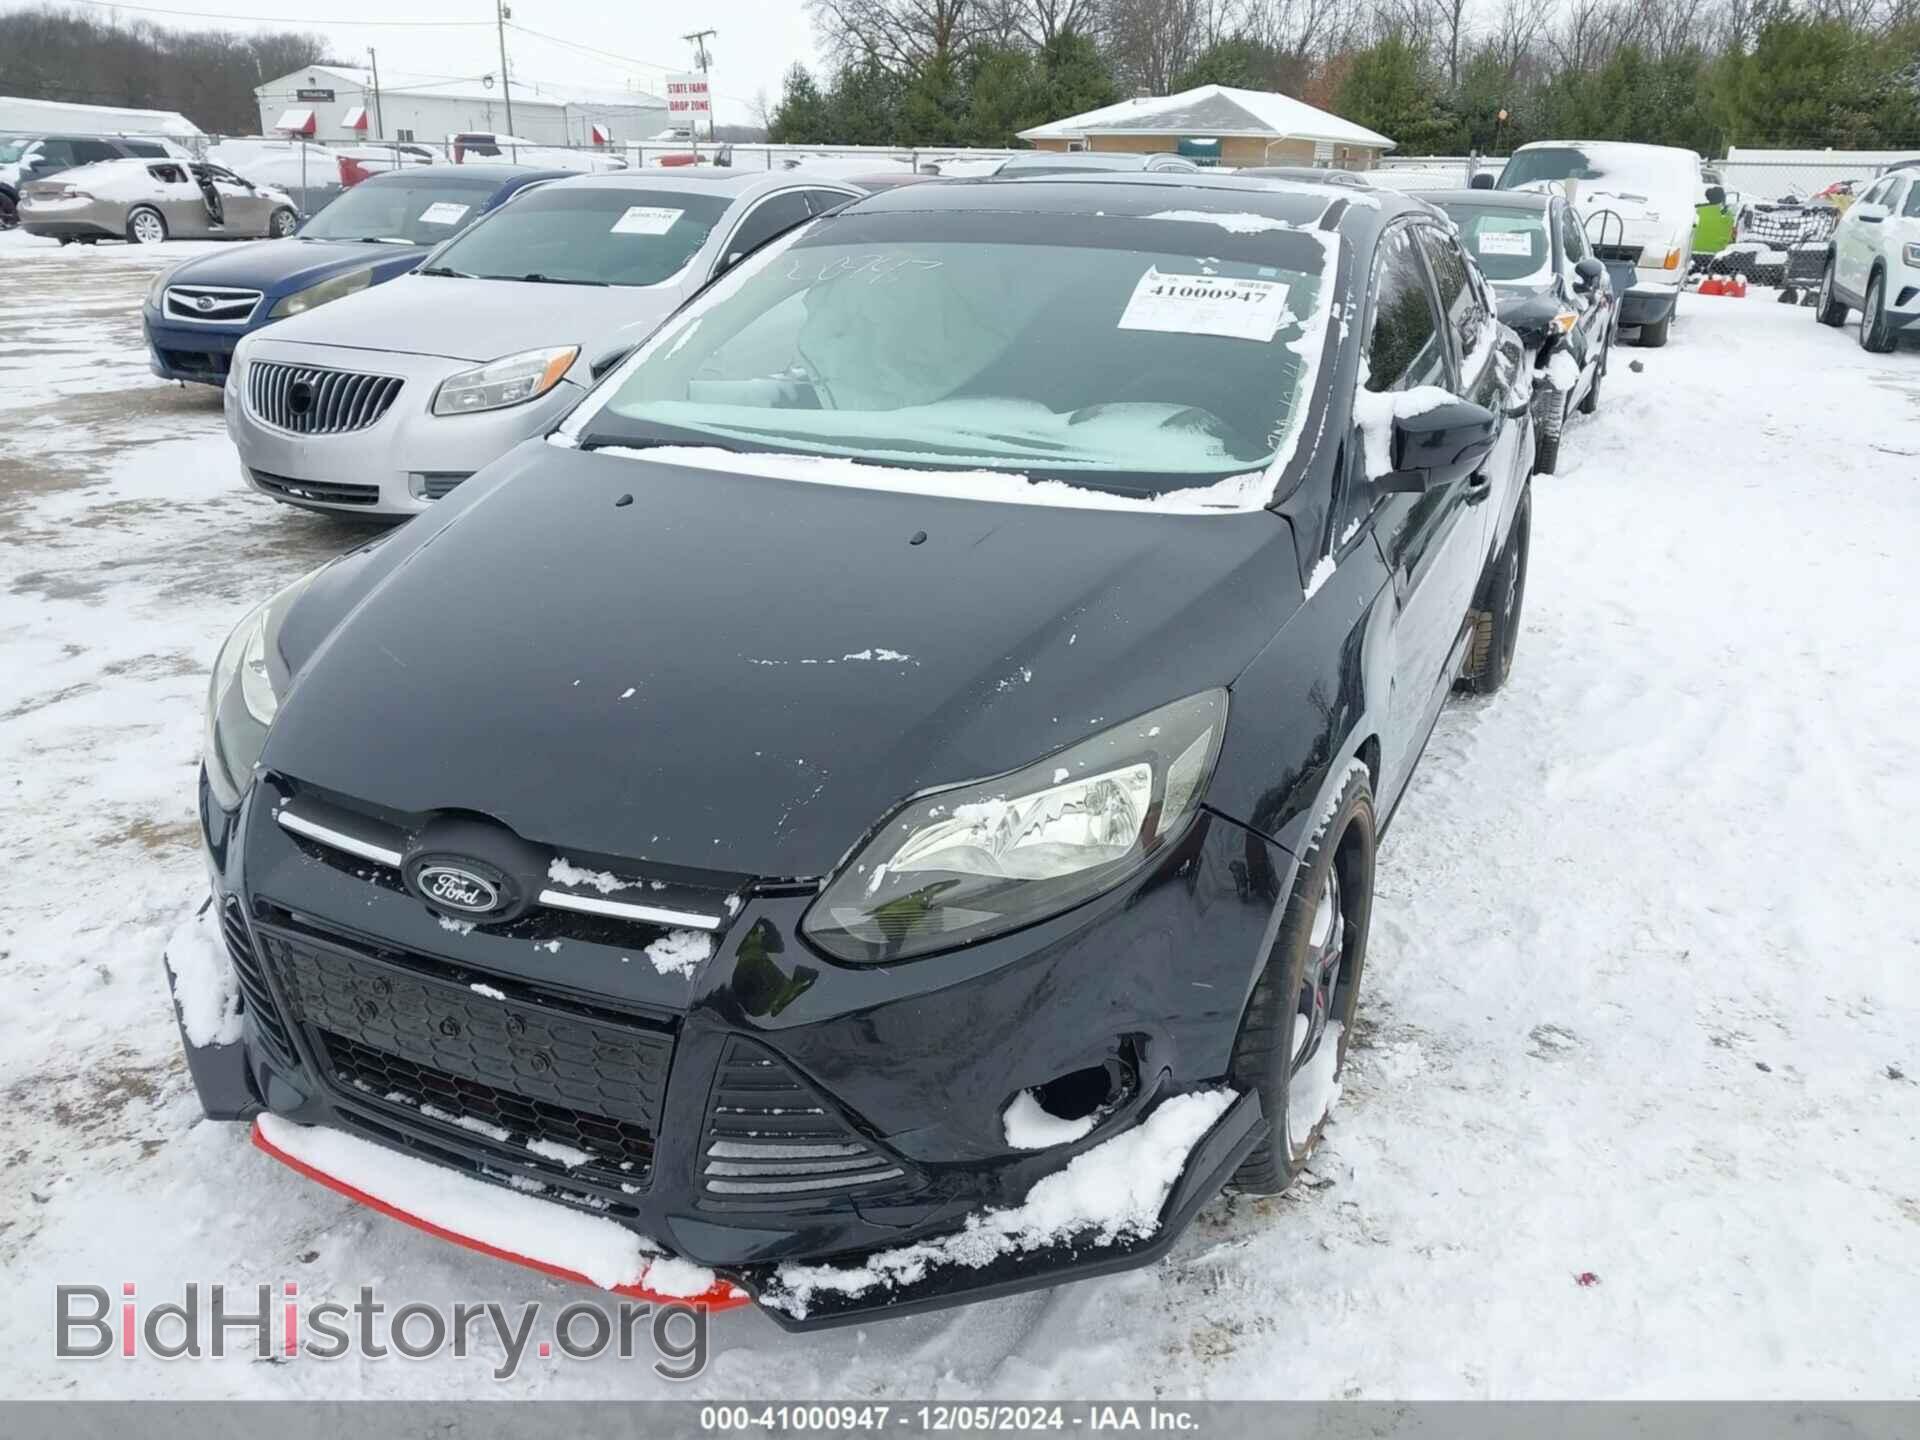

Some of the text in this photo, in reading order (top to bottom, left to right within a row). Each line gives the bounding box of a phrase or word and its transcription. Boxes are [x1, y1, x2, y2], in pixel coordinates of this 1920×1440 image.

[667, 82, 707, 94] STATE FARM
[669, 100, 708, 111] DROP ZONE
[1150, 285, 1267, 303] 41000947
[432, 873, 480, 905] Ford
